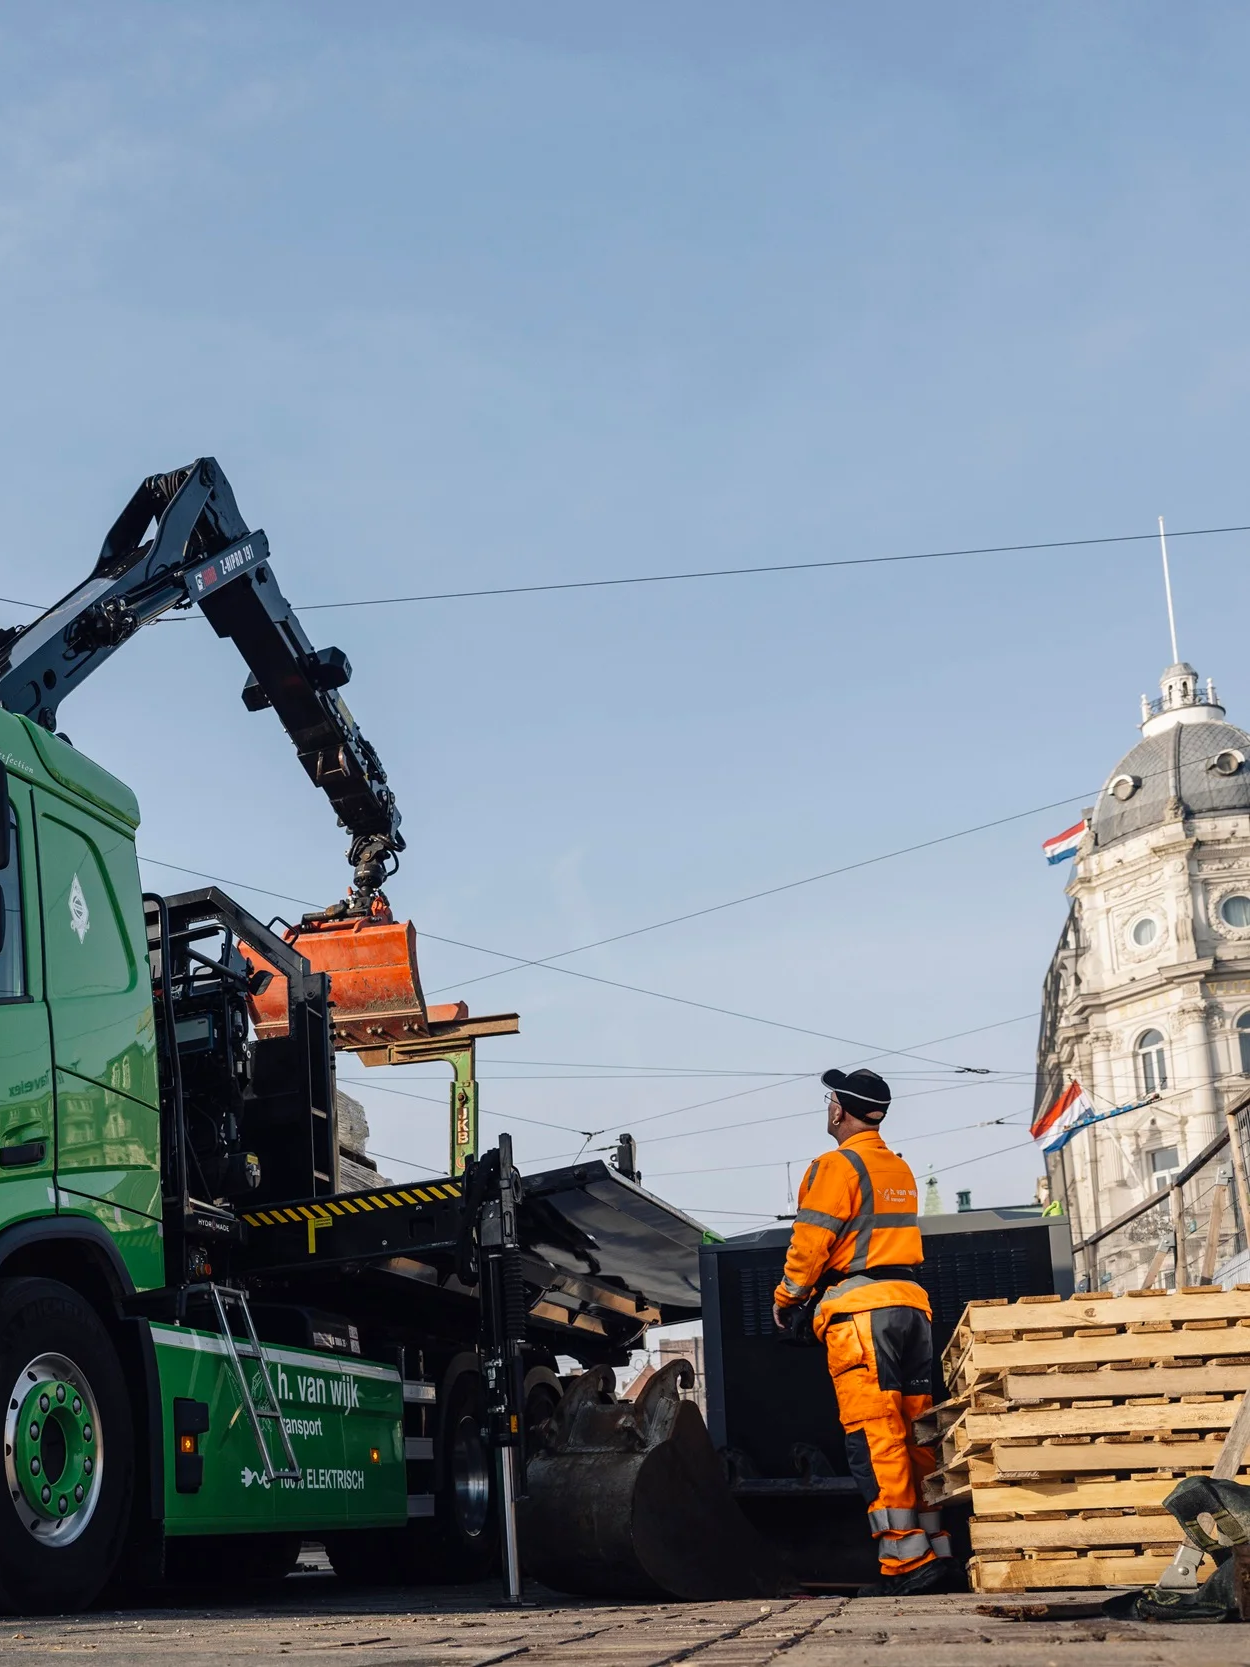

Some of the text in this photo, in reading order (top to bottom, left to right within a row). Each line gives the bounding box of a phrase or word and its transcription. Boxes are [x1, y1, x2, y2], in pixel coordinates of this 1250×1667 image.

[457, 1107, 469, 1144] JKB
[277, 1363, 360, 1416] h. van wijk
[306, 1468, 365, 1490] ELEKTRISCH
